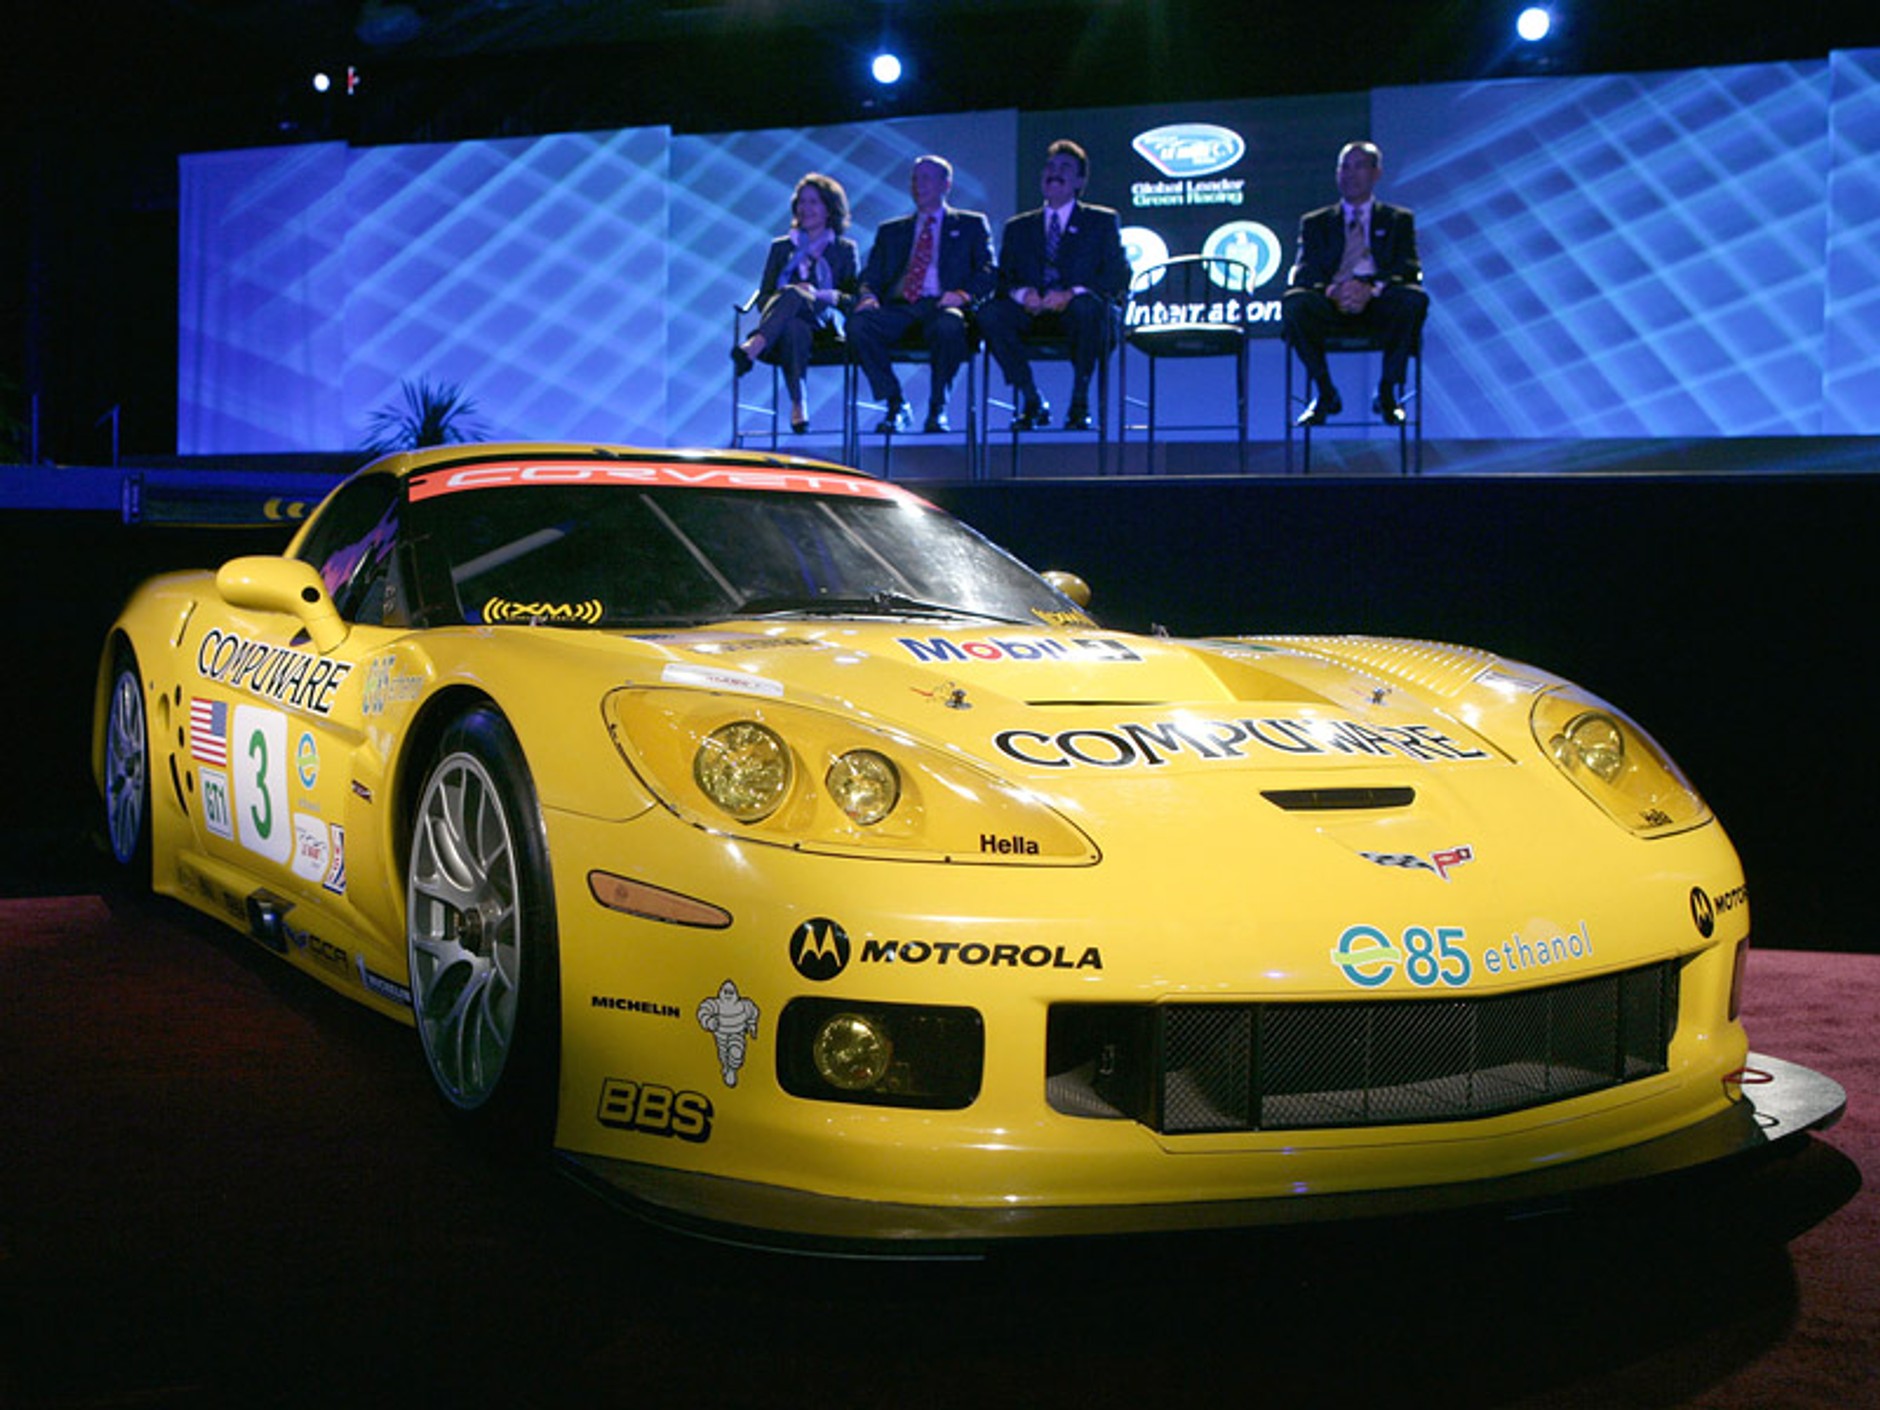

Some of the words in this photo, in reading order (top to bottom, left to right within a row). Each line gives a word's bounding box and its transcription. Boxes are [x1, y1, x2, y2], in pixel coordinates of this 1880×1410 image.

[198, 630, 351, 714] COMPUWARE
[898, 637, 1068, 662] Mobil
[995, 718, 1487, 767] COMPUWARE
[205, 780, 228, 827] GT1
[249, 729, 272, 840] 3
[979, 834, 1040, 856] Hella
[860, 940, 1103, 970] MOTOROLA
[1485, 921, 1593, 974] ethanol
[591, 995, 680, 1018] MICHELIN
[597, 1078, 715, 1143] BBS
